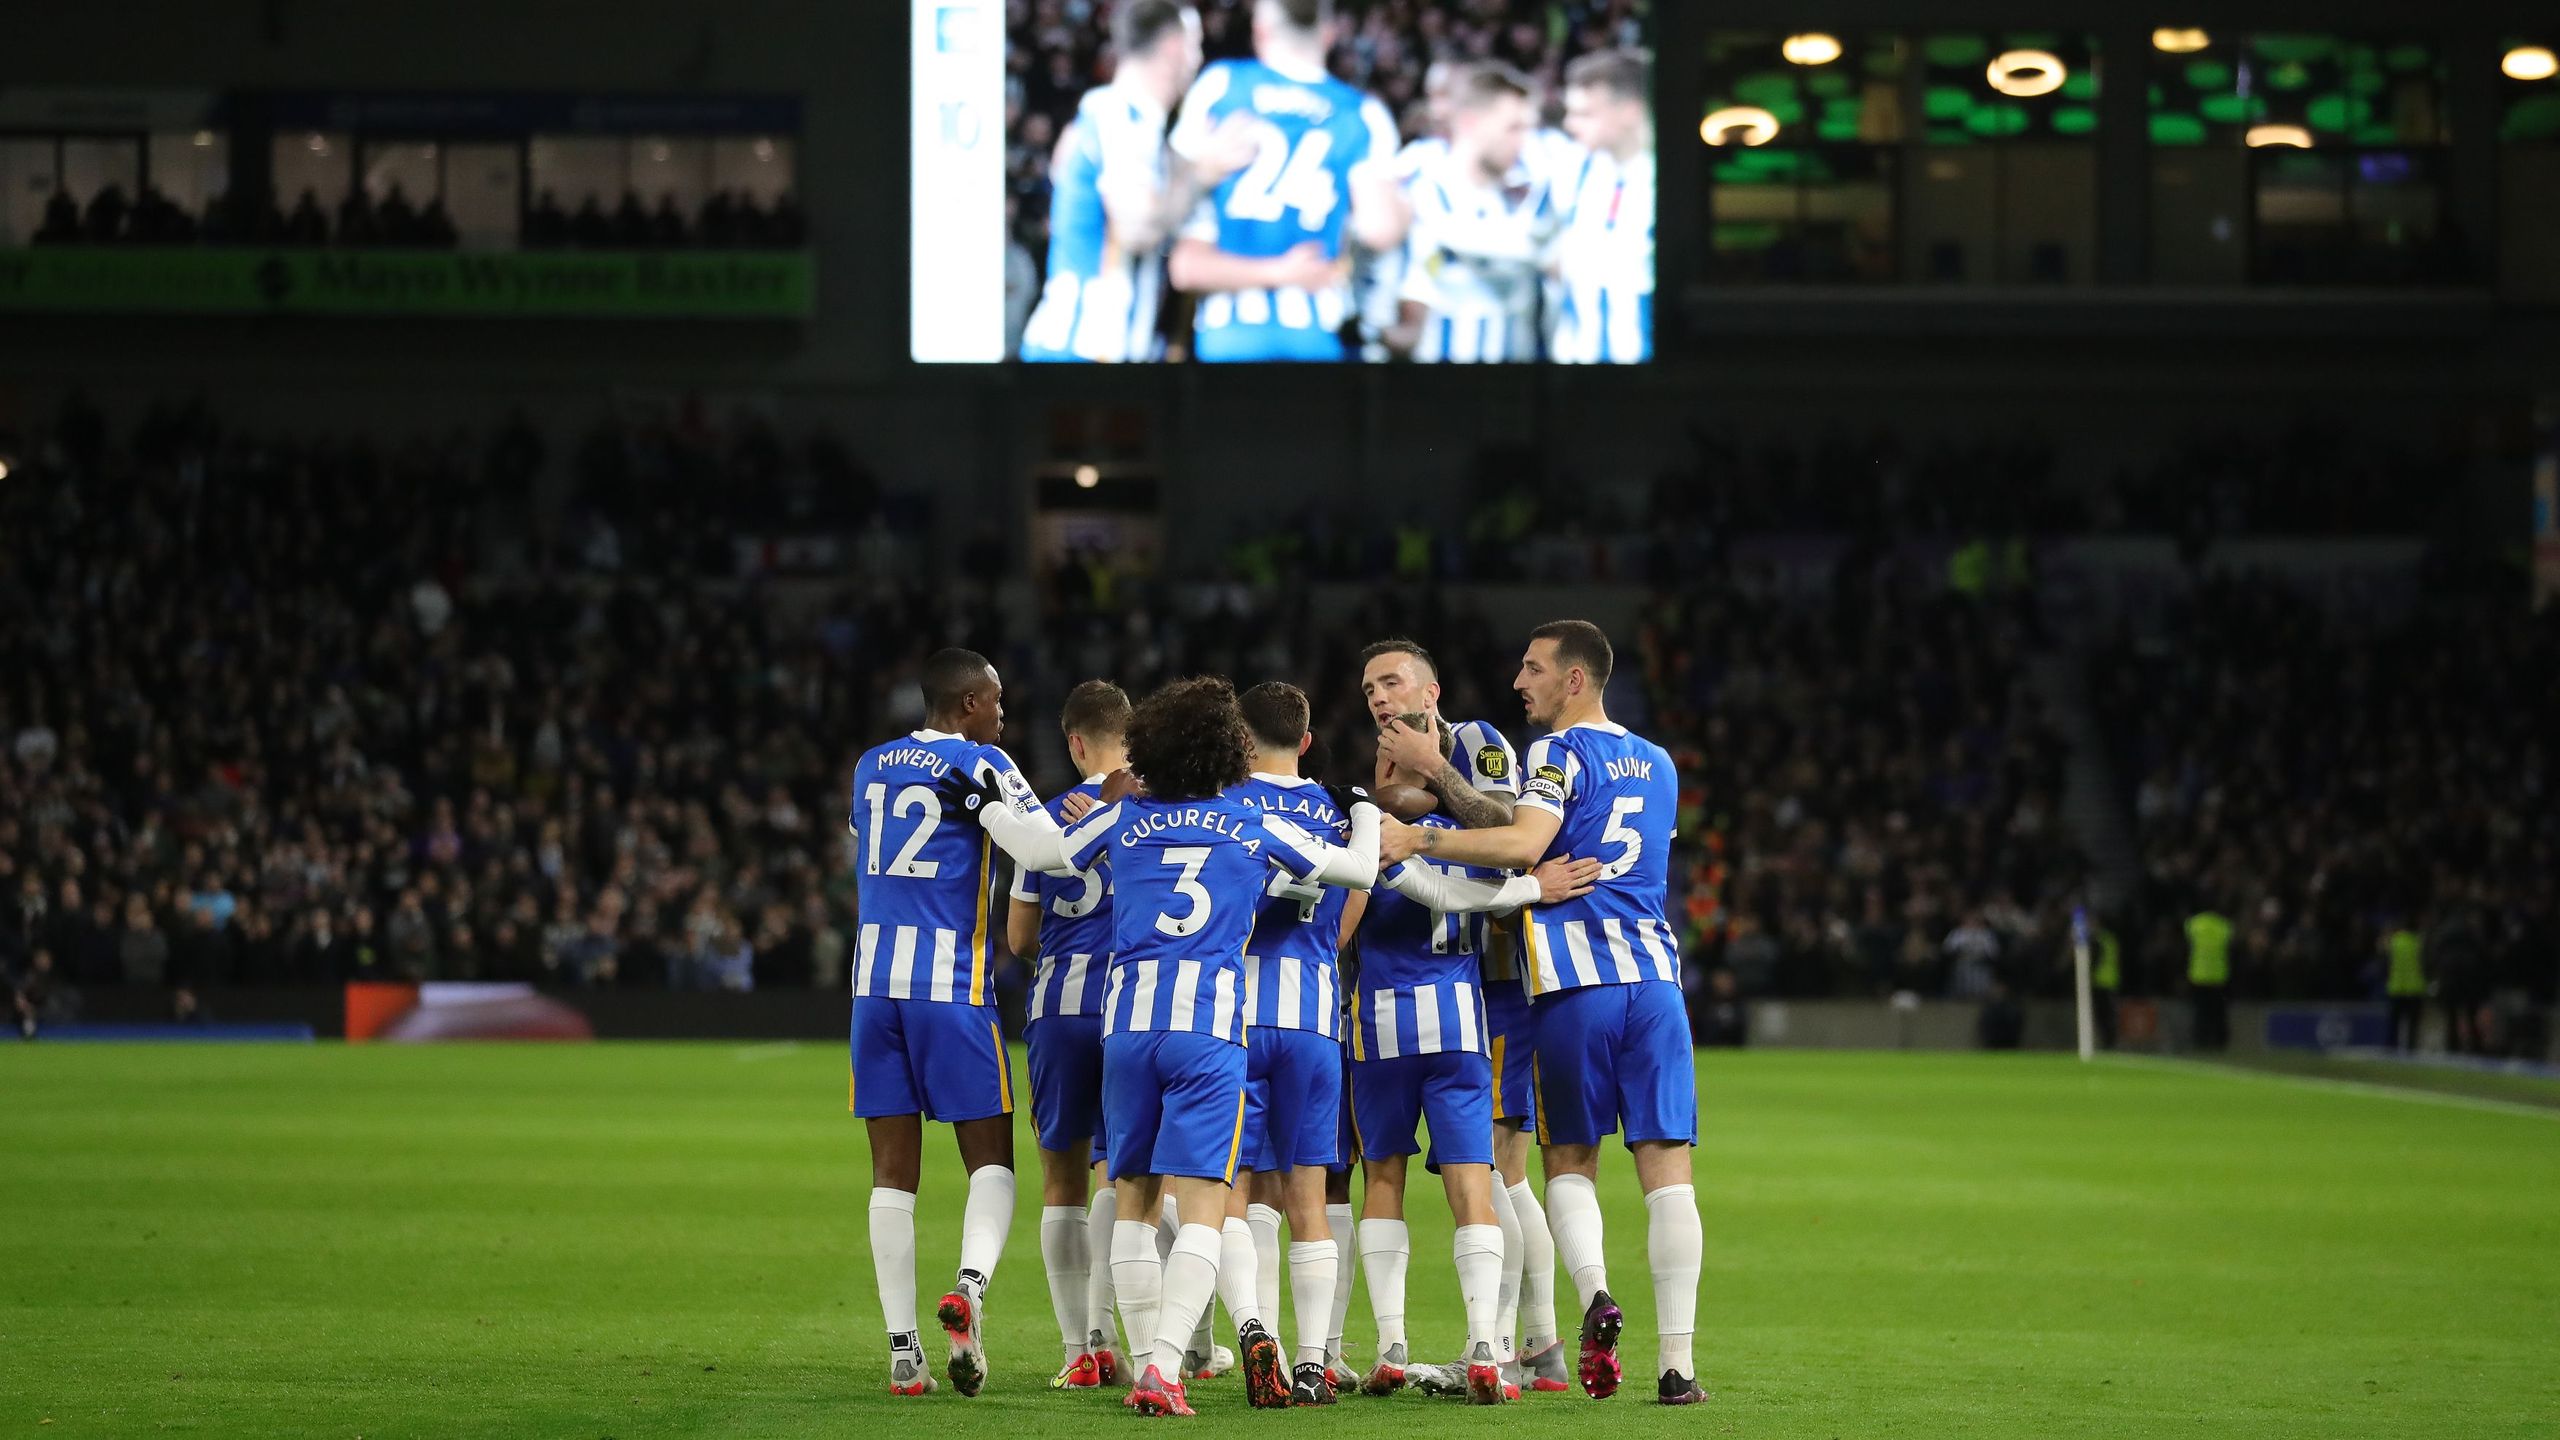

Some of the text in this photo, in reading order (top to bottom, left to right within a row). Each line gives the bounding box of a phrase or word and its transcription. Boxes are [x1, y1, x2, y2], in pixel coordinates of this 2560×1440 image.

[1225, 117, 1339, 232] 24
[878, 748, 950, 778] MWEPU
[1605, 757, 1653, 781] DUNK
[864, 782, 943, 879] 12
[1121, 808, 1262, 856] CUCURELLA
[1597, 796, 1643, 881] 5
[1154, 846, 1212, 938] 3
